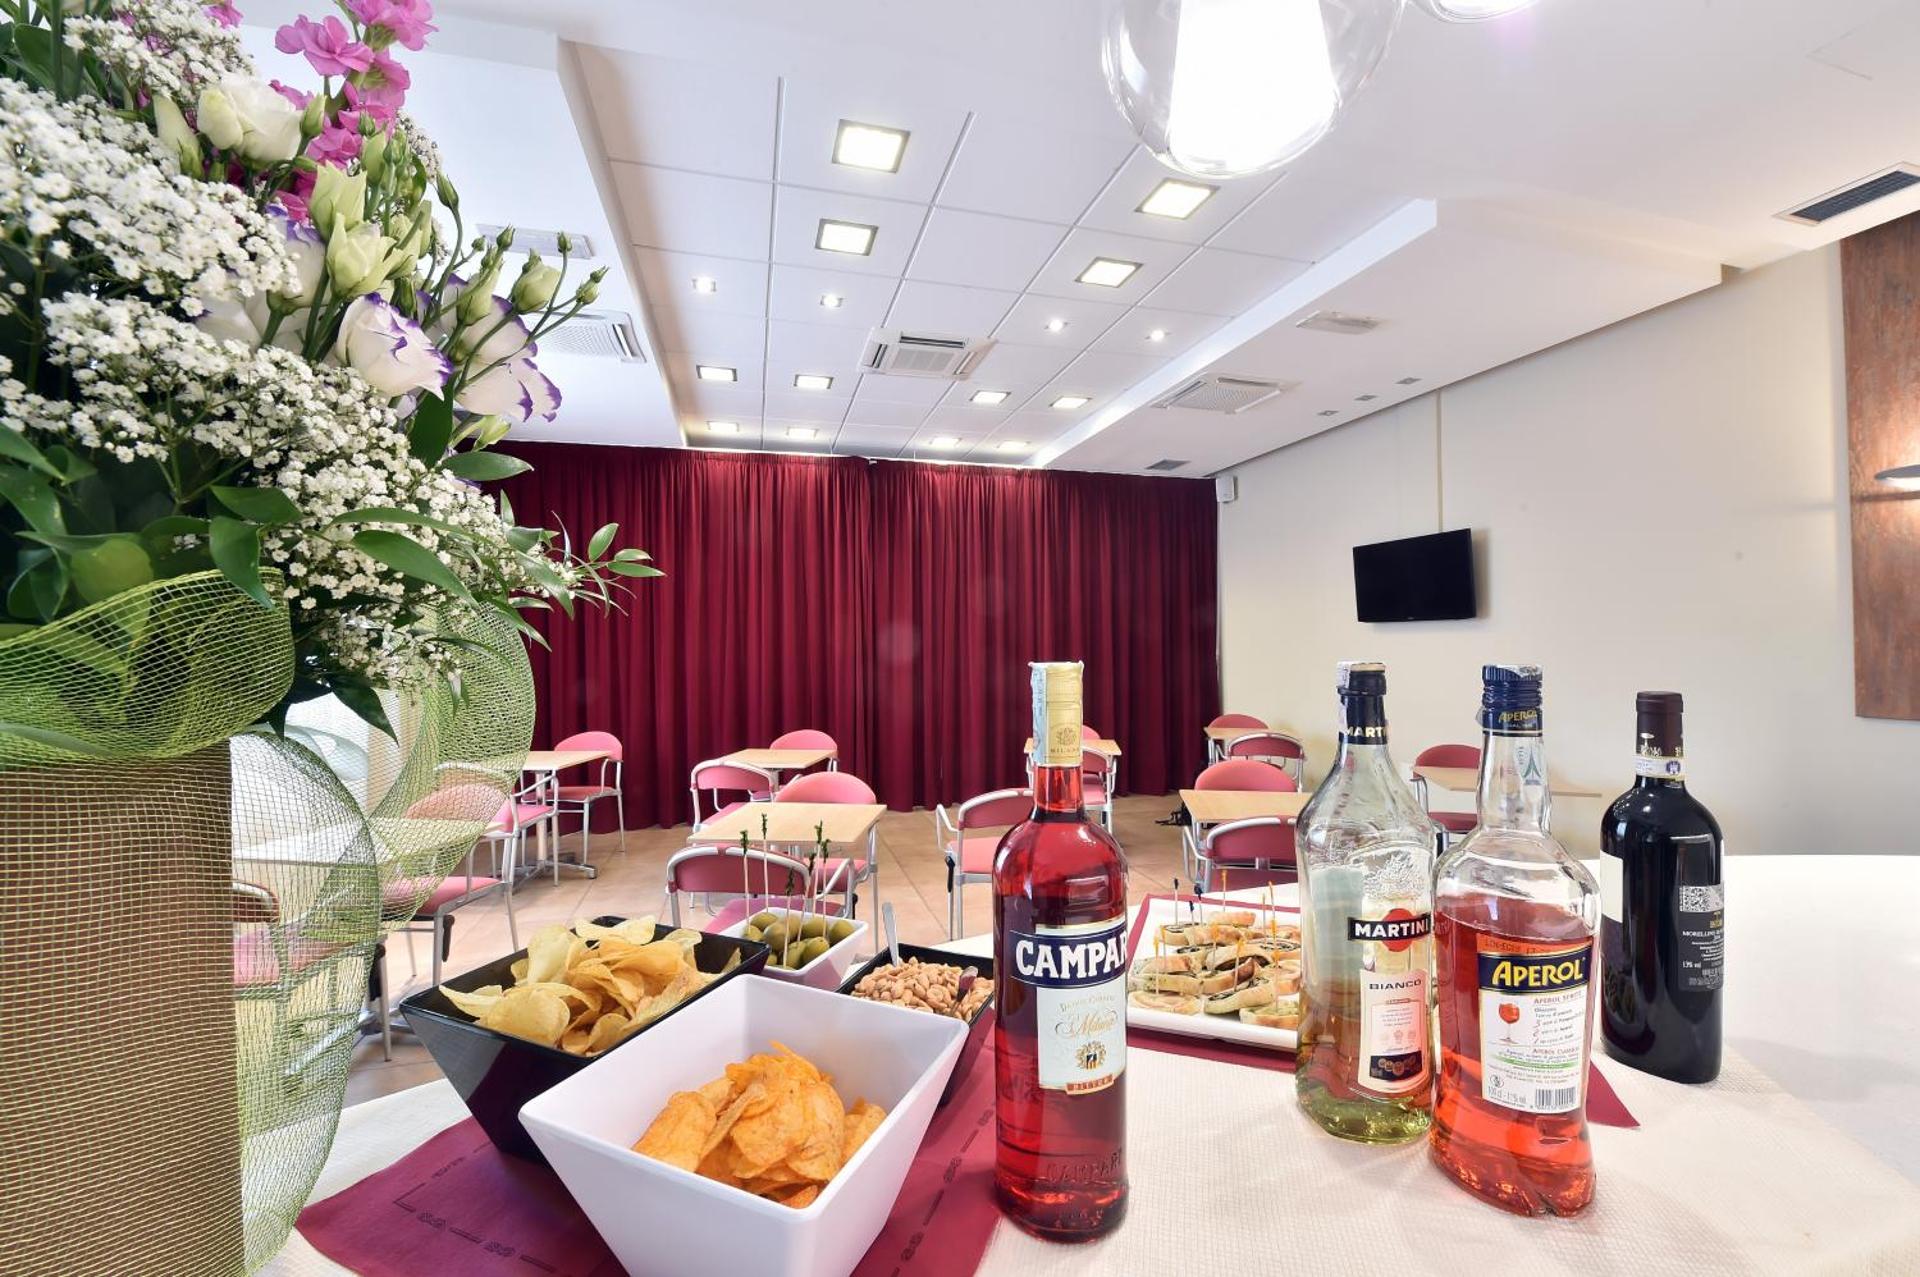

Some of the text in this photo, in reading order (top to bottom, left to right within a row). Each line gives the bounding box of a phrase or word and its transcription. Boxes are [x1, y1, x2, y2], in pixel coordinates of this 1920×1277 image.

[1354, 918, 1429, 938] MARTINI
[1491, 959, 1583, 987] APEROL
[1369, 979, 1422, 990] BIANCO
